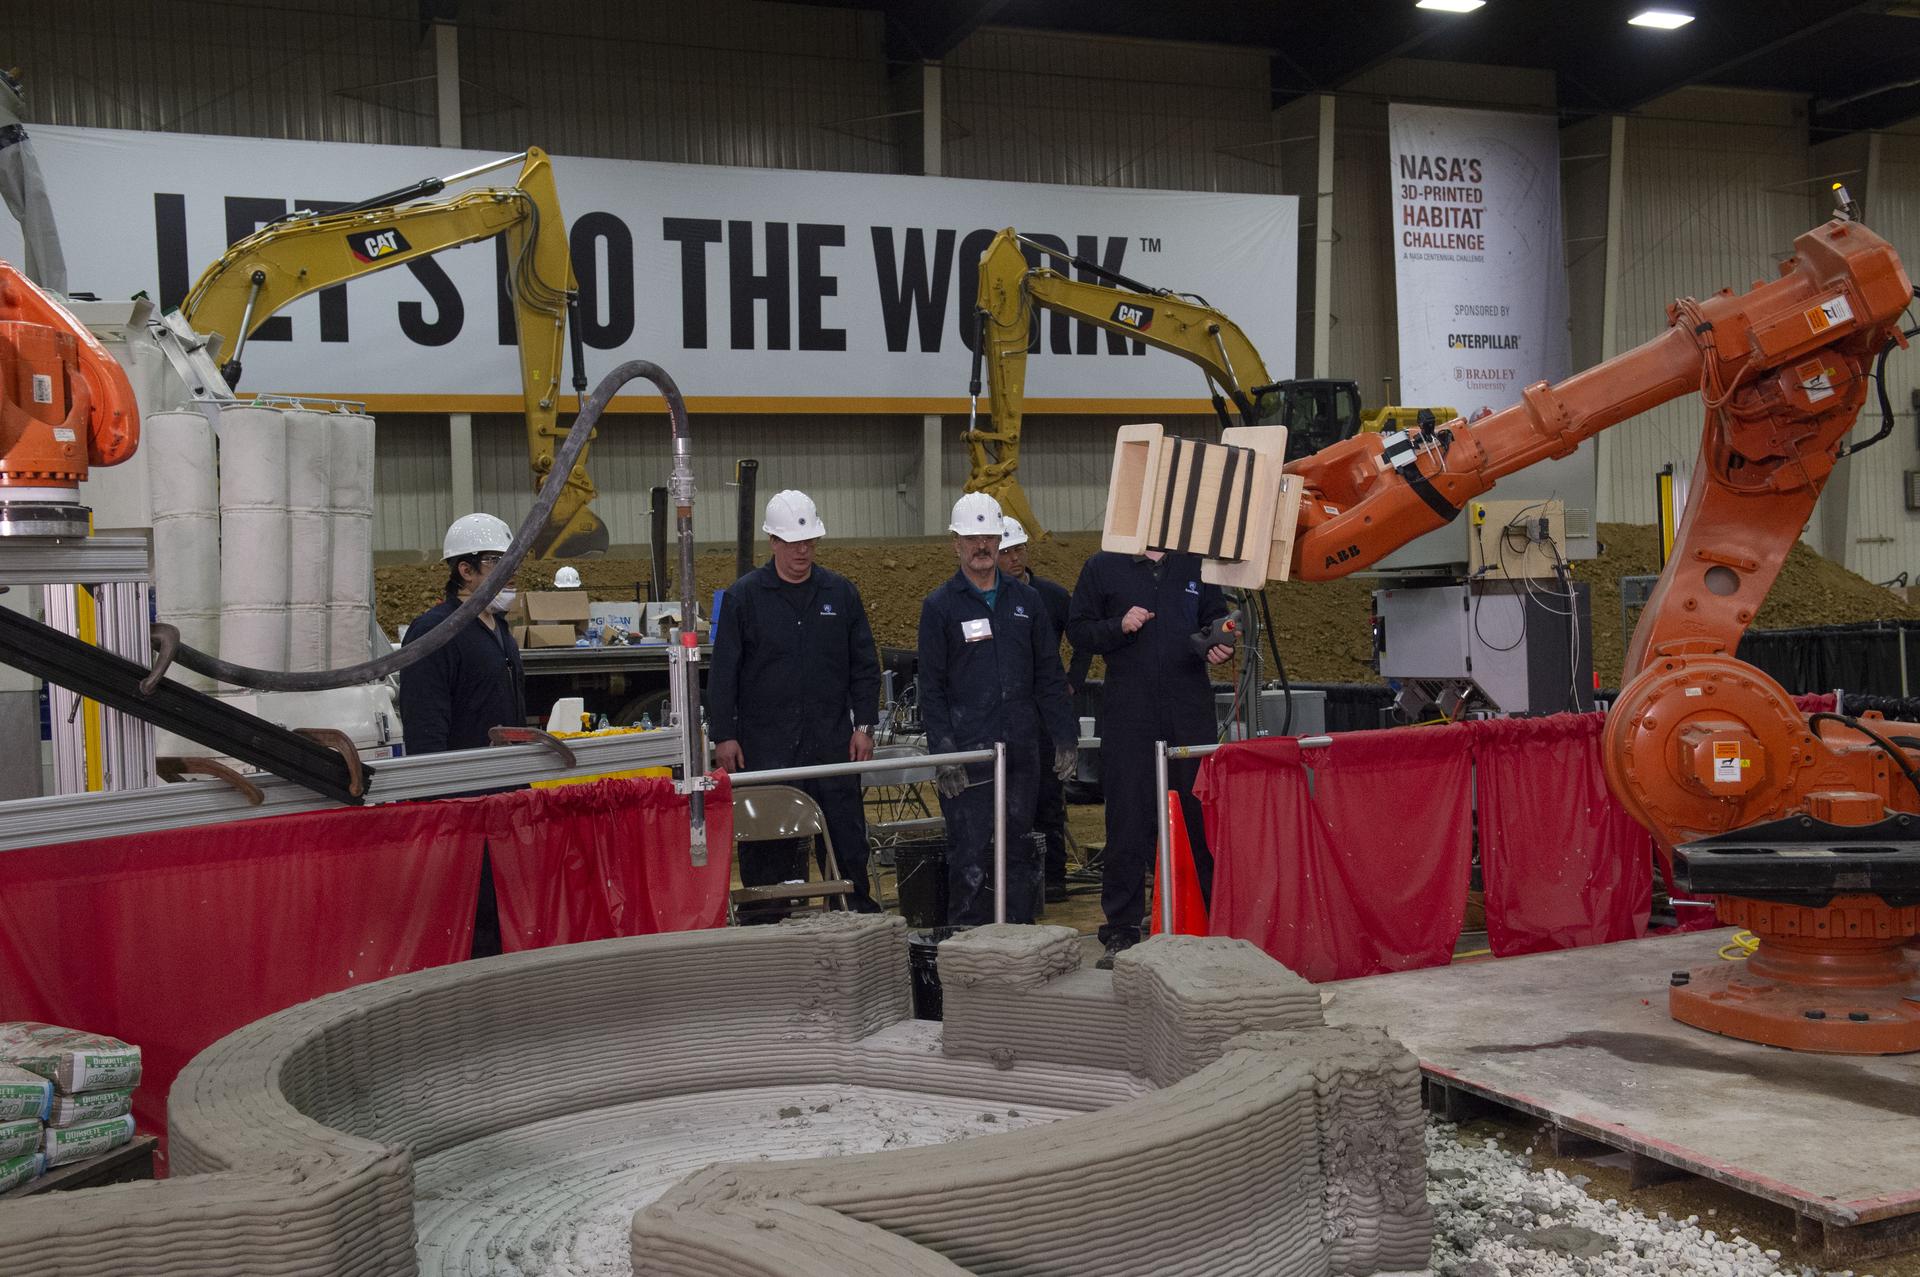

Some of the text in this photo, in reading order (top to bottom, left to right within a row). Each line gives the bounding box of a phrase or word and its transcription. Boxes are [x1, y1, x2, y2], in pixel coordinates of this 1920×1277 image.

[1401, 154, 1483, 183] NASA'S
[1401, 184, 1483, 204] 3D-PRINTED
[1403, 205, 1484, 230] HABITAT
[365, 231, 398, 257] CAT
[1403, 231, 1485, 251] CHALLENGE
[496, 211, 635, 350] O
[663, 217, 847, 351] THE
[1118, 305, 1143, 327] CAT
[1454, 304, 1510, 317] SPONSORED BY
[1448, 334, 1519, 350] CATERPILLAR
[1466, 368, 1516, 380] BRADLEY
[1467, 382, 1505, 392] University
[1325, 544, 1361, 570] ABB
